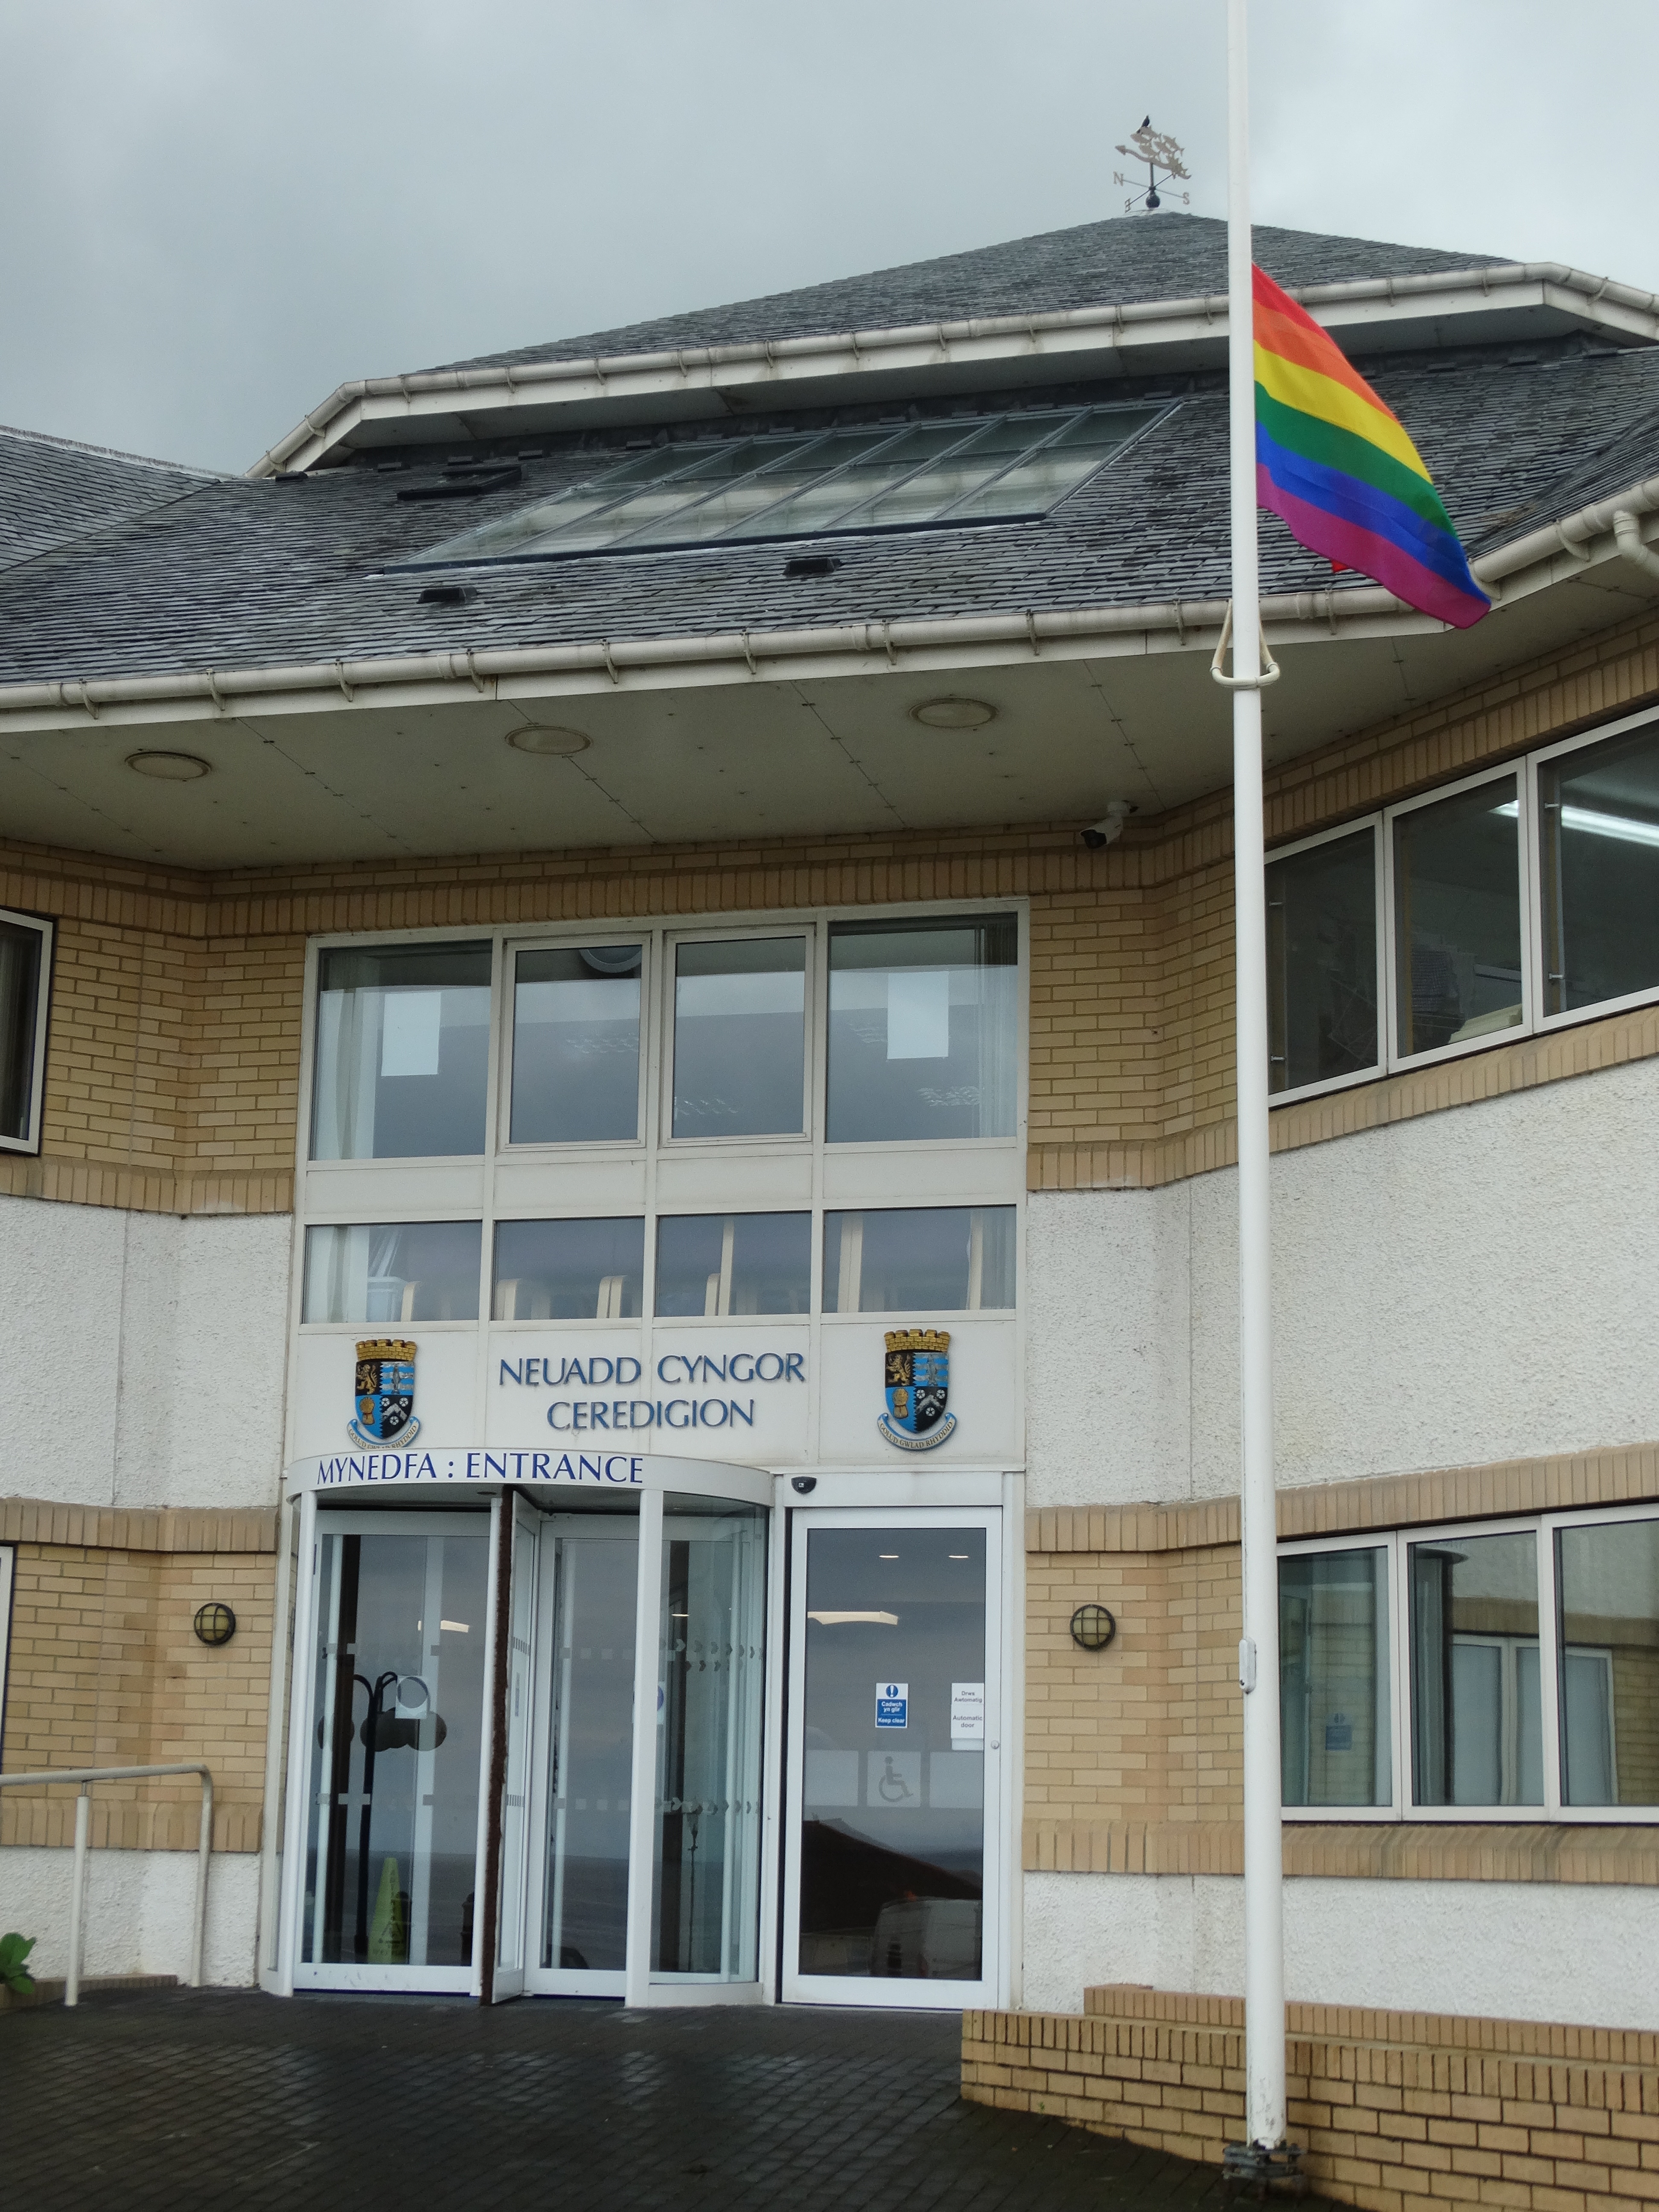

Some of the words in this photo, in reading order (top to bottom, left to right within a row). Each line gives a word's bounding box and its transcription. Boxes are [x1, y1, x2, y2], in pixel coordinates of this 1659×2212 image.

[1113, 171, 1124, 186] N
[1182, 191, 1190, 205] S
[499, 1356, 642, 1386] NEUADD
[657, 1352, 805, 1383] CYNGOR
[547, 1398, 754, 1429] CEREDIGION
[349, 1428, 367, 1448] GOLUD
[879, 1423, 899, 1444] GOLUD
[899, 1439, 925, 1449] GWLAD
[926, 1421, 953, 1447] RHYDDID
[317, 1453, 437, 1485] MYNEDFA
[466, 1452, 643, 1483] ENTRANCE
